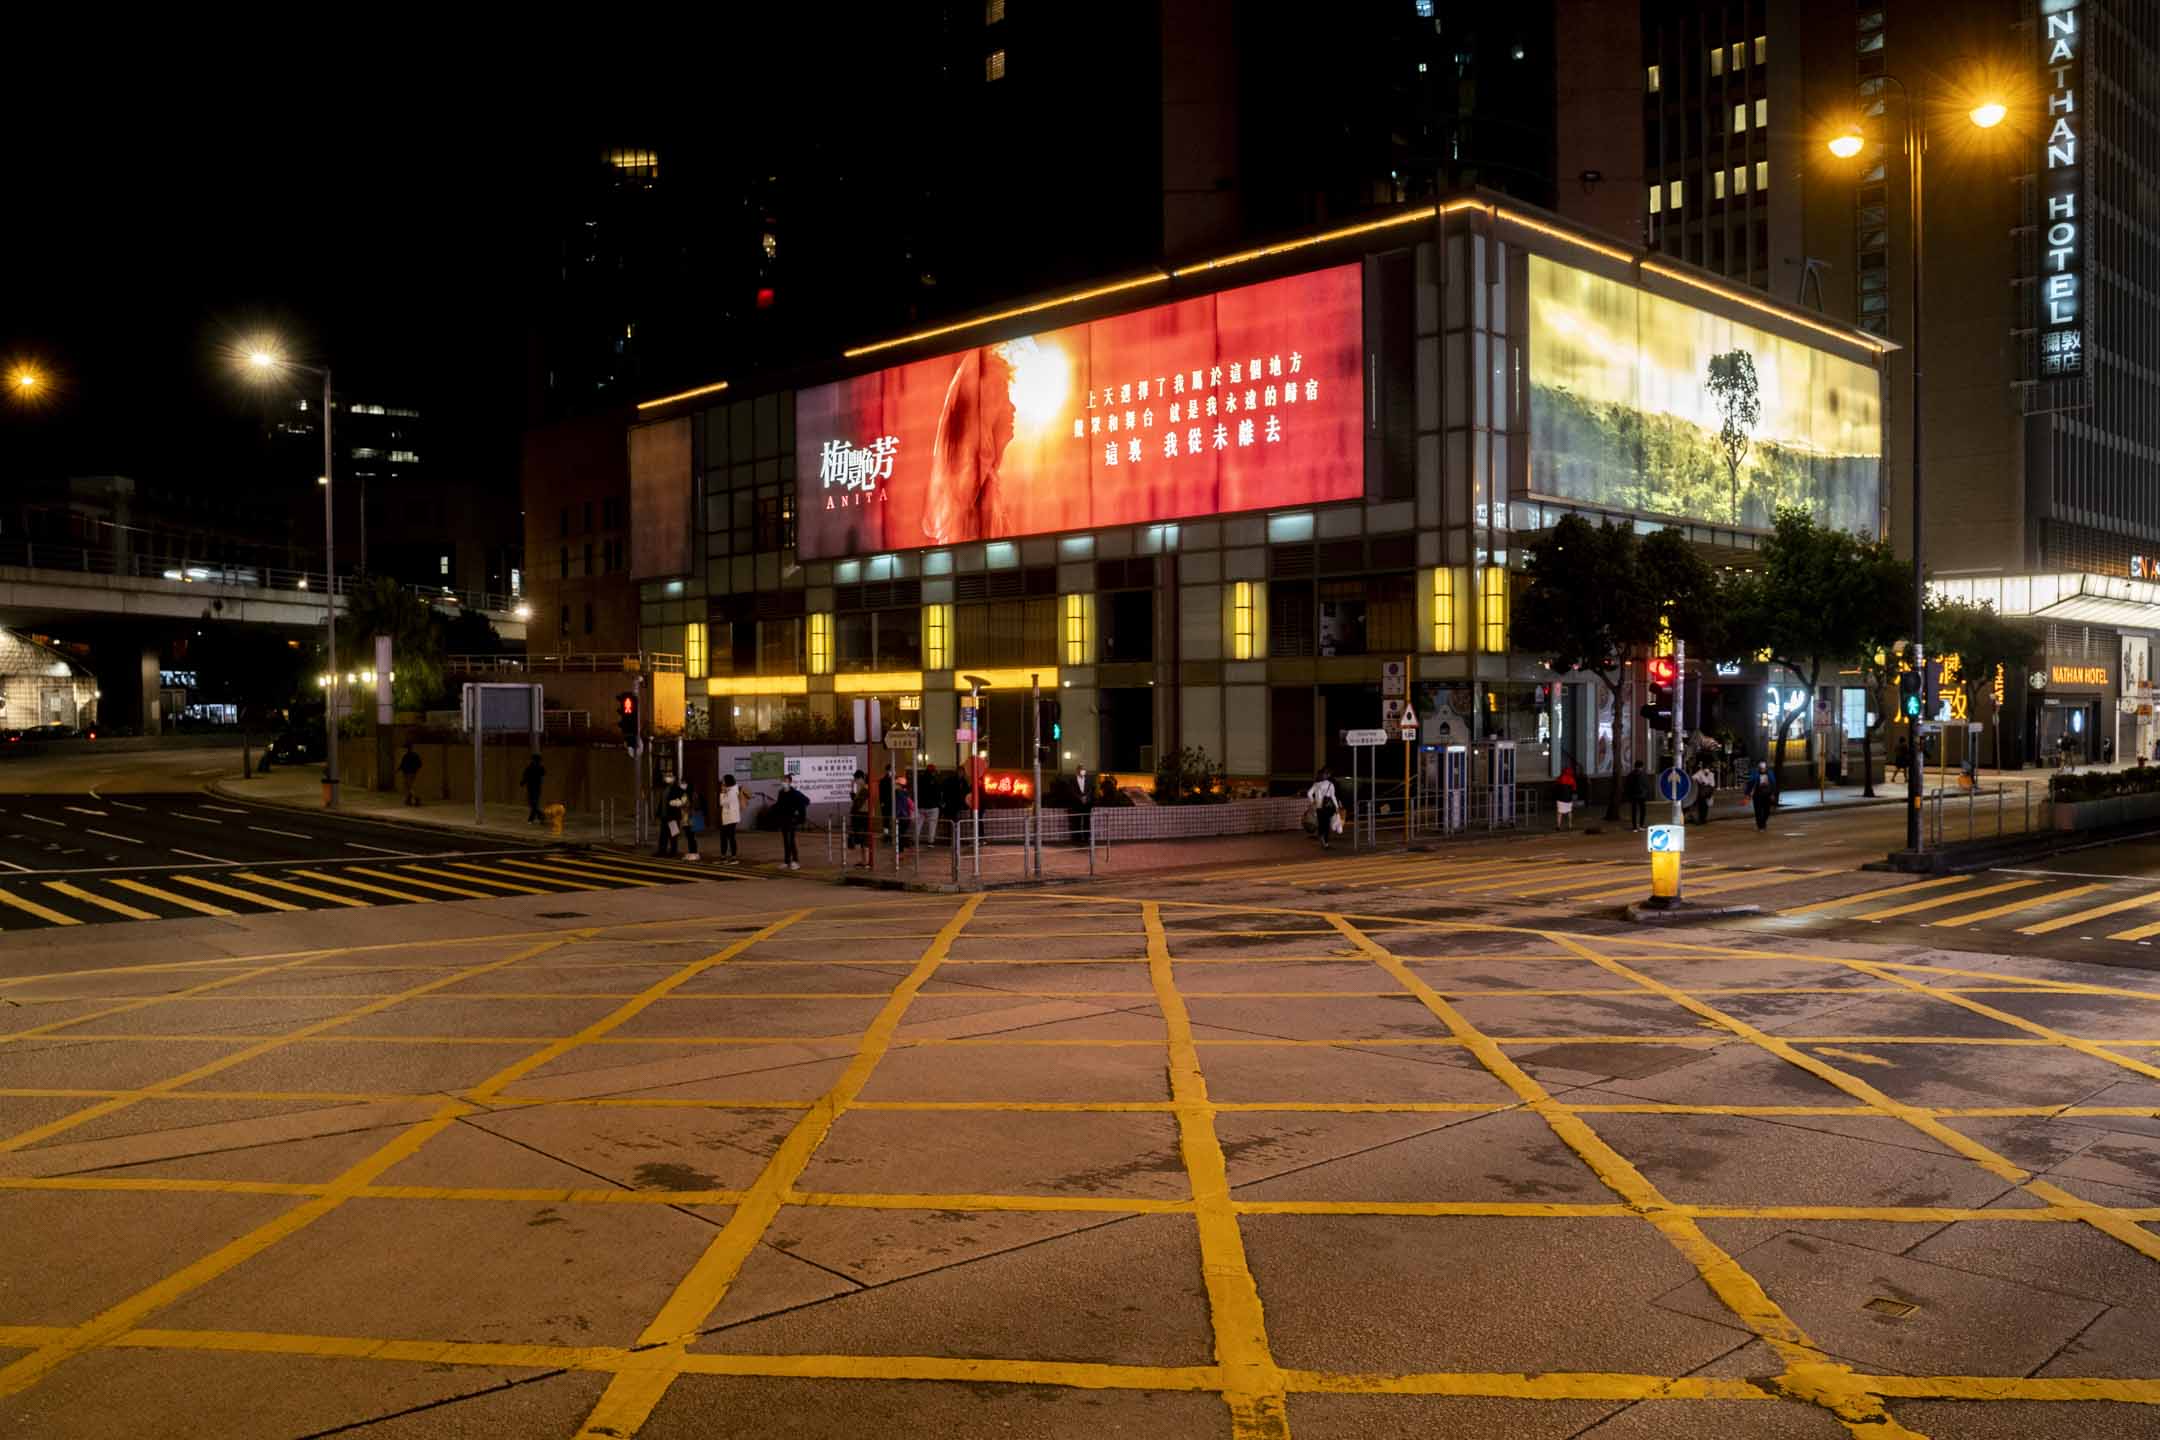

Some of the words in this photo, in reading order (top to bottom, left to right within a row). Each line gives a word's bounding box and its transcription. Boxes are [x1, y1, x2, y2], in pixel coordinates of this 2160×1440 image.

[2048, 10, 2076, 168] NATHAN
[2048, 193, 2076, 325] HOTEL
[1086, 352, 1302, 408] 上天選擇了我屬於這個地方
[1164, 414, 1281, 458] 我從未離去
[826, 488, 888, 510] ANITA
[2052, 666, 2083, 684] NATHAN
[2085, 667, 2109, 685] HOTEL
